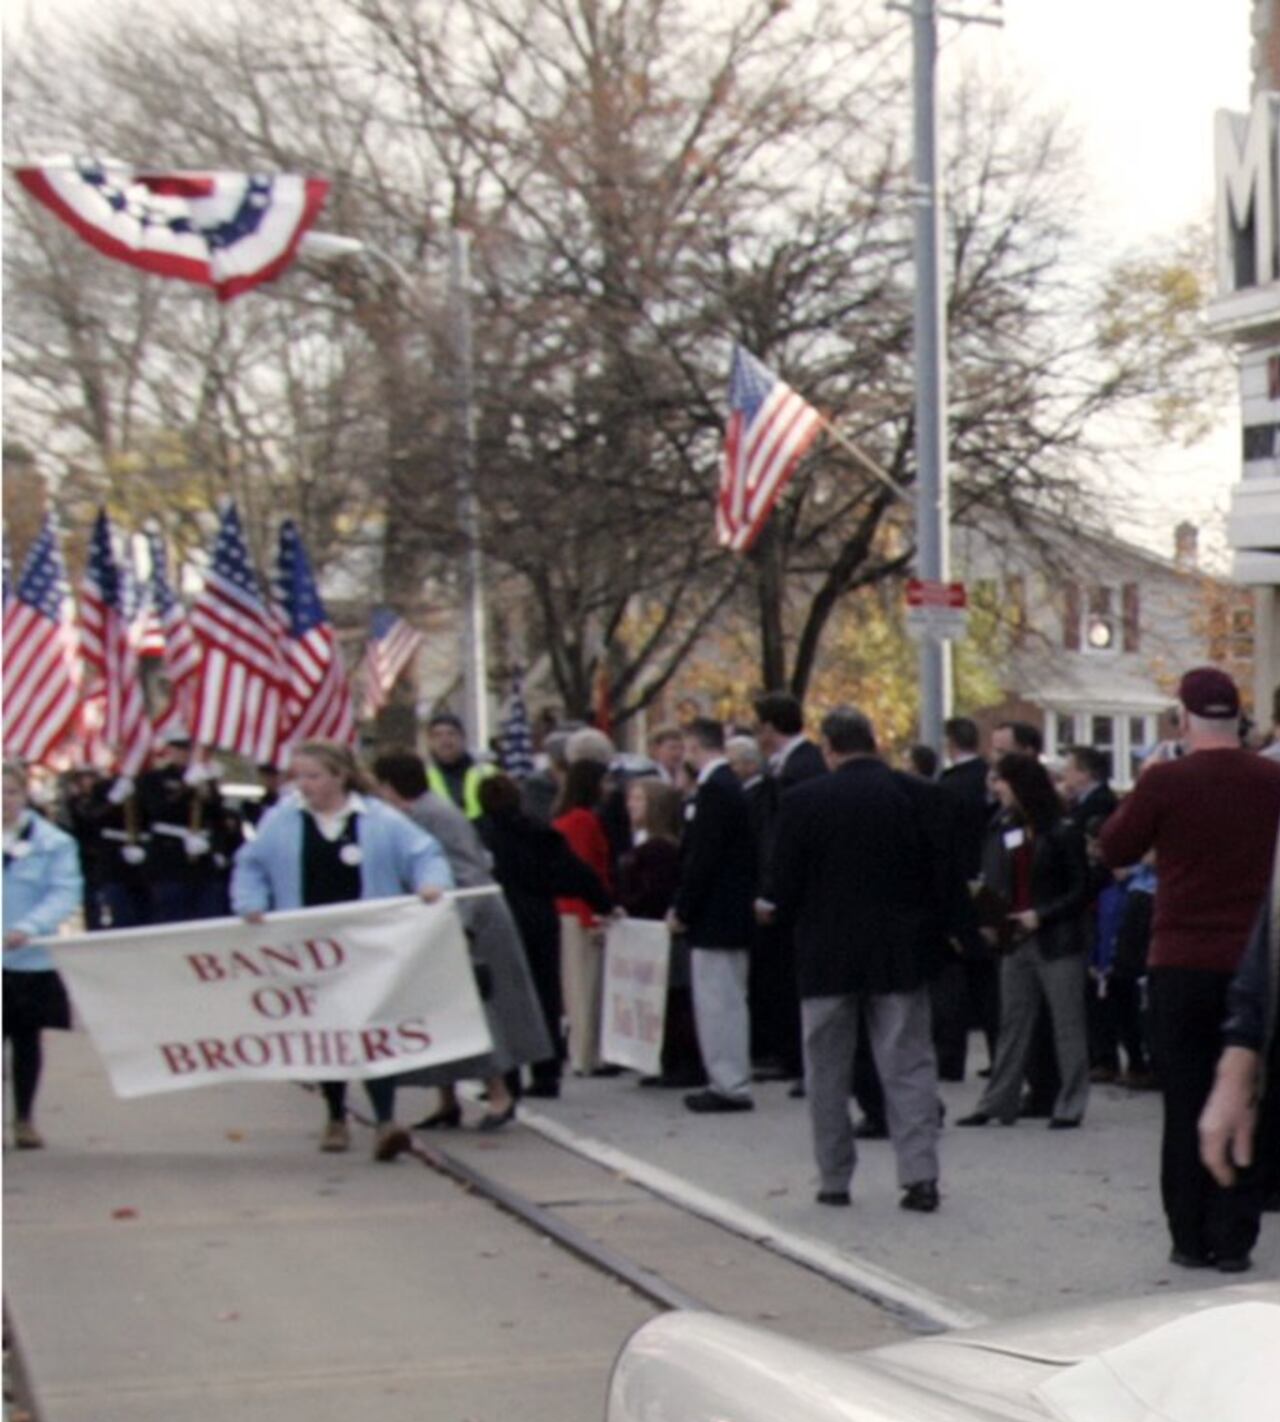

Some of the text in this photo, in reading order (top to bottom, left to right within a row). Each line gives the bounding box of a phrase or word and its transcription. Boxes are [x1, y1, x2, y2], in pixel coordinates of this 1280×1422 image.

[185, 936, 346, 982] BAND
[250, 987, 320, 1020] OF
[158, 1019, 433, 1076] BROTHERS
